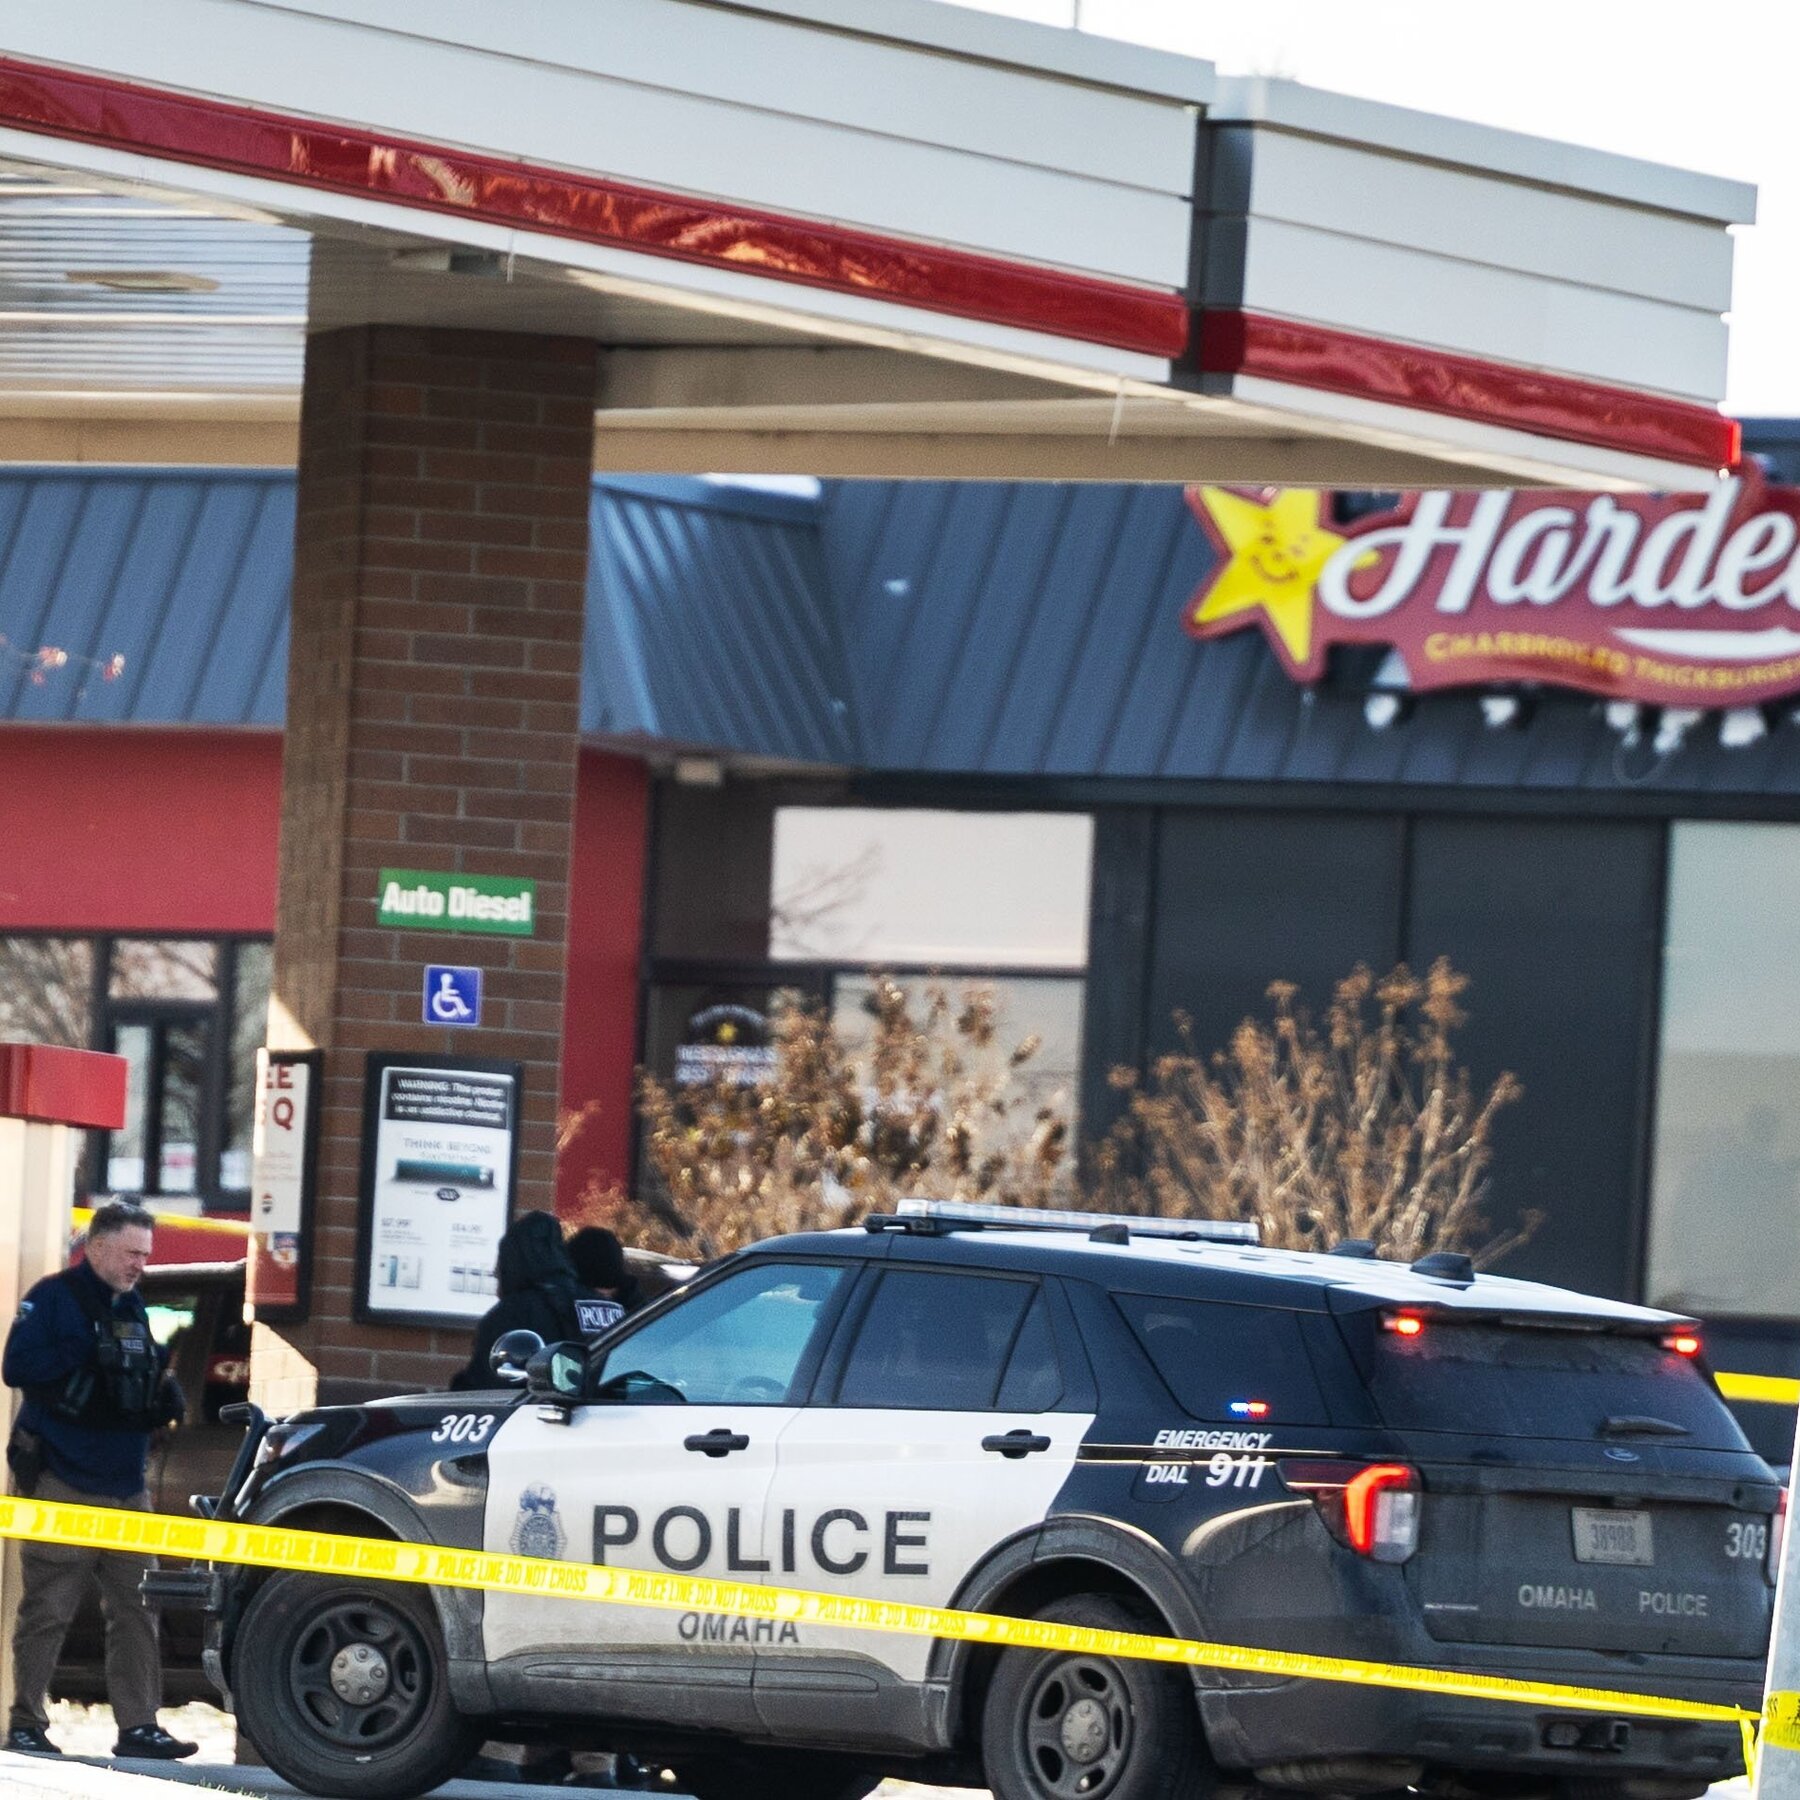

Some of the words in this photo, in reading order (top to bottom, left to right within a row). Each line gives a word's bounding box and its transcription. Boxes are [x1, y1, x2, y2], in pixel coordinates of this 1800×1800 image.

[1321, 477, 1800, 619] Harde
[381, 881, 445, 916] Auto
[447, 886, 532, 922] Diesel
[431, 1413, 495, 1442] 303
[1153, 1430, 1273, 1449] EMERGENCY
[1145, 1465, 1189, 1484] DIAL
[1205, 1453, 1266, 1488] 911
[592, 1504, 932, 1575] POLICE
[1724, 1522, 1767, 1559] 303
[435, 1554, 477, 1580] POLICE
[477, 1559, 504, 1583] LINE
[505, 1561, 523, 1585] DO
[523, 1563, 549, 1587] NOT
[549, 1566, 588, 1591] CROSS
[627, 1575, 669, 1600] POLICE
[669, 1579, 694, 1603] LINE
[695, 1582, 714, 1605] DO
[714, 1584, 739, 1608] NOT
[739, 1586, 778, 1612] CROSS
[1518, 1584, 1598, 1611] OMAHA
[1639, 1591, 1709, 1617] POLICE
[678, 1611, 799, 1643] OMAHA
